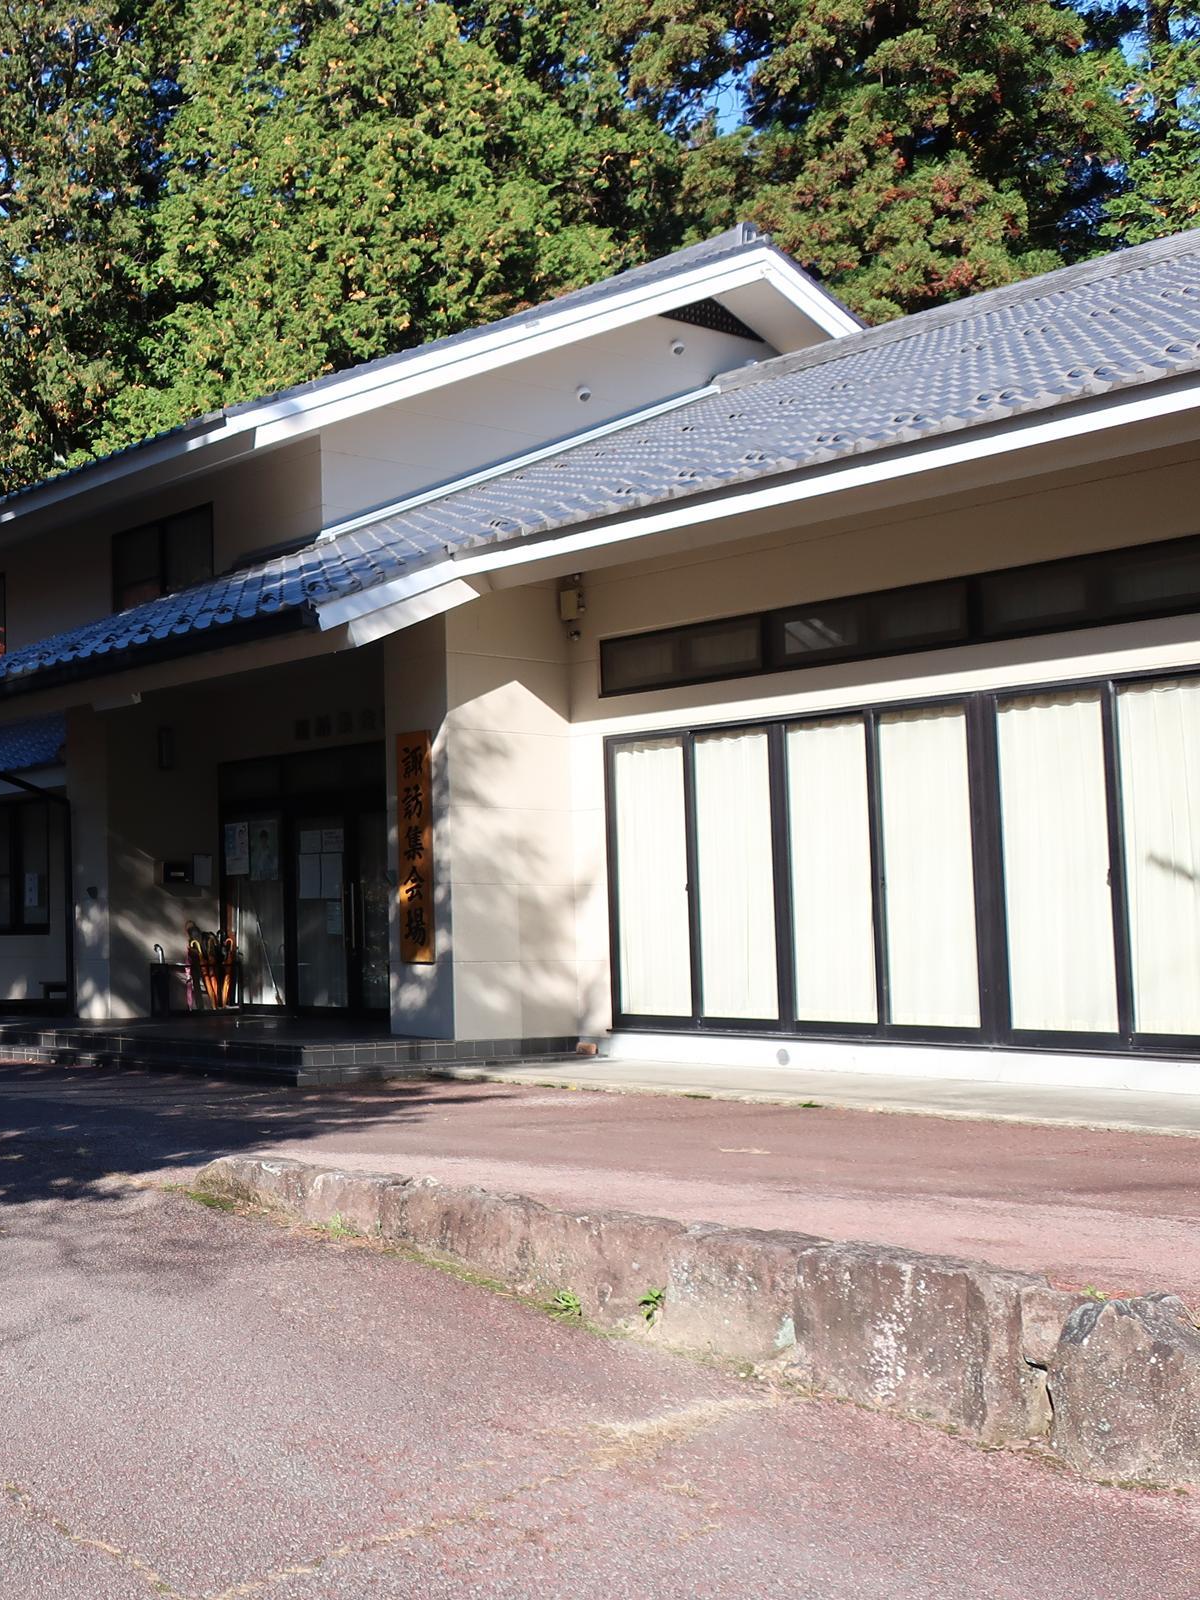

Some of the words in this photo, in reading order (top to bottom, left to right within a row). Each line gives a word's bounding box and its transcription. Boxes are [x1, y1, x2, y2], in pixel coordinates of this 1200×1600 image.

[402, 746, 427, 946] 諏訪集会場
